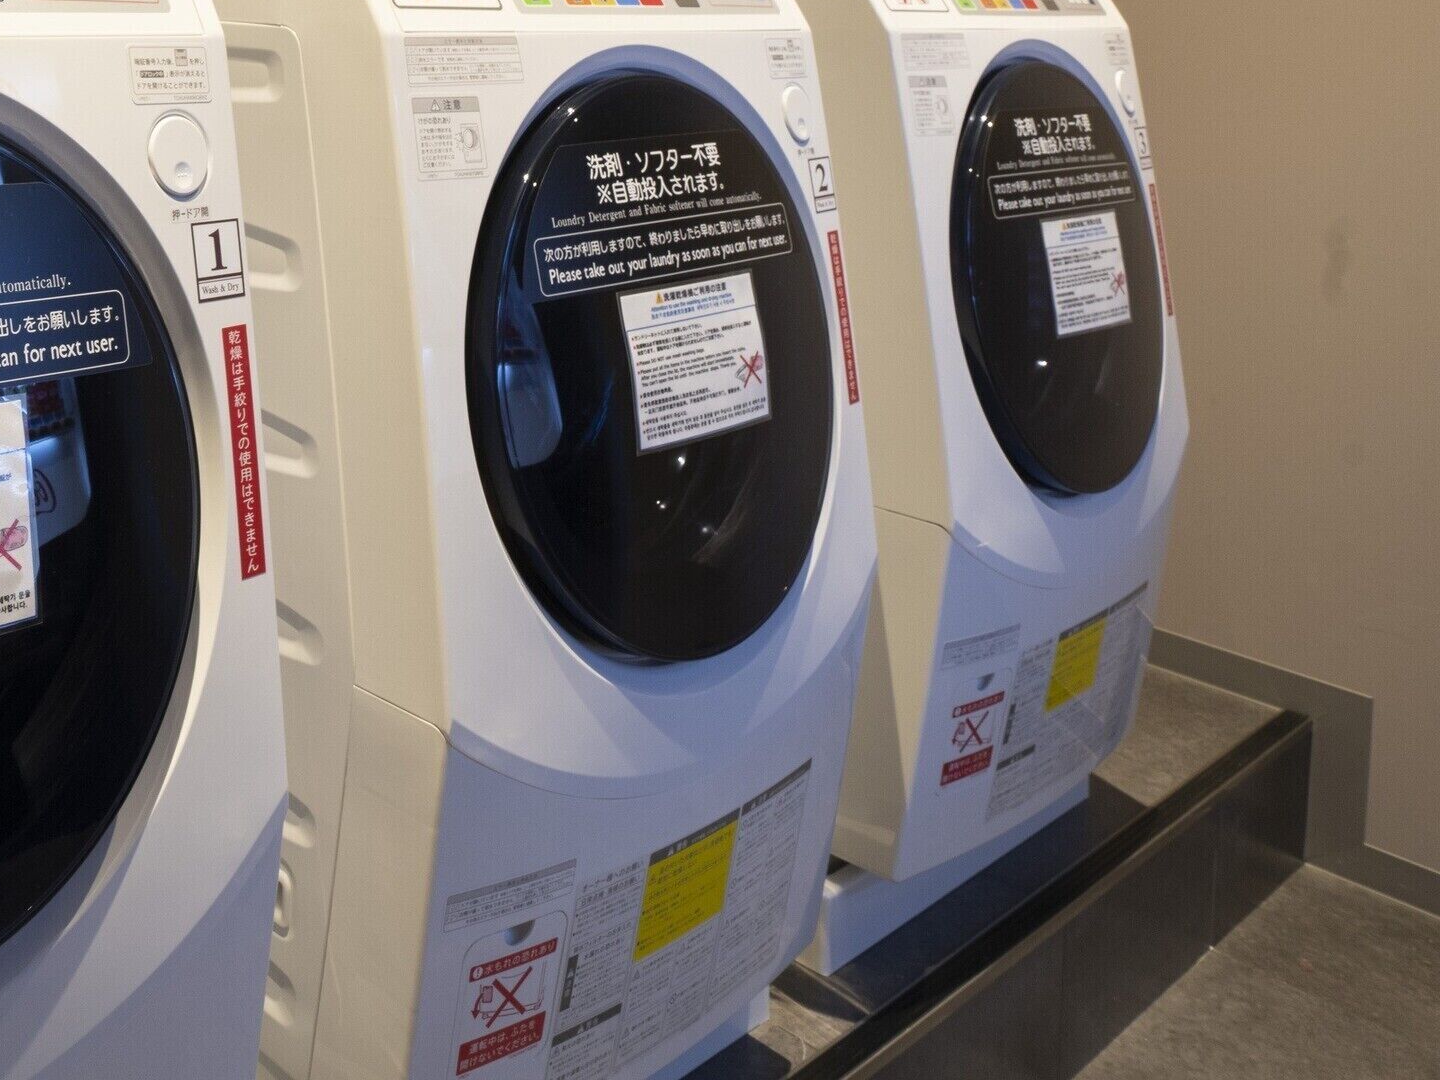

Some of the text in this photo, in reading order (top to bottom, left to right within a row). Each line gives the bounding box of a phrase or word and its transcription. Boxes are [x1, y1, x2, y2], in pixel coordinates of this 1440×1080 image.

[586, 142, 721, 180] 洗剤・ソフター不要
[815, 163, 829, 193] 2
[551, 215, 585, 228] Loundry
[588, 209, 626, 222] Detergent
[629, 206, 642, 217] and
[644, 202, 667, 215] Fabric
[208, 228, 228, 271] 1
[548, 268, 582, 285] Please
[584, 262, 606, 279] take
[608, 261, 625, 275] out
[627, 258, 647, 276] your
[648, 250, 680, 268] laundry
[682, 250, 691, 262] as
[692, 247, 711, 261] soon
[711, 246, 720, 257] as
[722, 244, 735, 259] you
[735, 241, 747, 253] can
[747, 236, 758, 250] for
[758, 237, 772, 249] next
[202, 281, 240, 295] Wash Dry
[24, 343, 45, 363] for
[51, 339, 82, 360] next
[86, 335, 119, 353] user.
[228, 330, 260, 574] 乾燥は手絞りでの使用はできません
